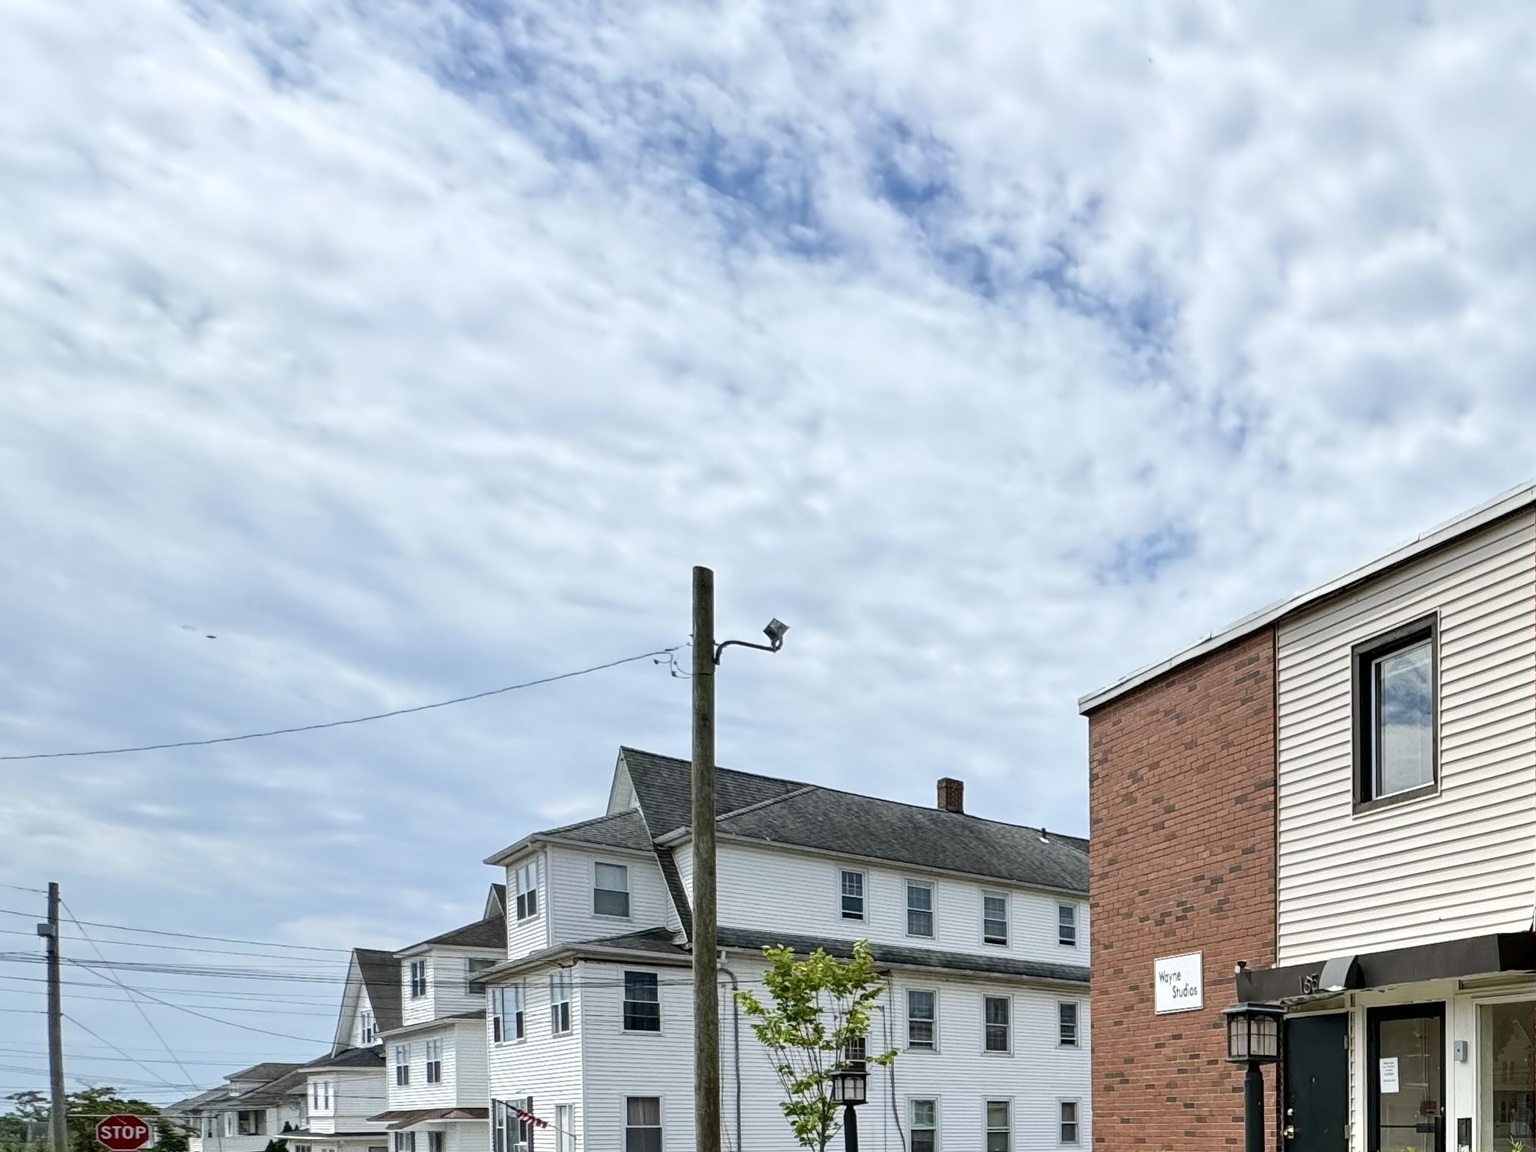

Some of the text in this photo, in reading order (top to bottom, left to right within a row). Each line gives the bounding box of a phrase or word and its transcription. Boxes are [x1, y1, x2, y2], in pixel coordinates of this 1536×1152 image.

[1158, 970, 1182, 986] Wayne
[1172, 983, 1198, 999] Studios
[100, 1125, 147, 1140] STOP
